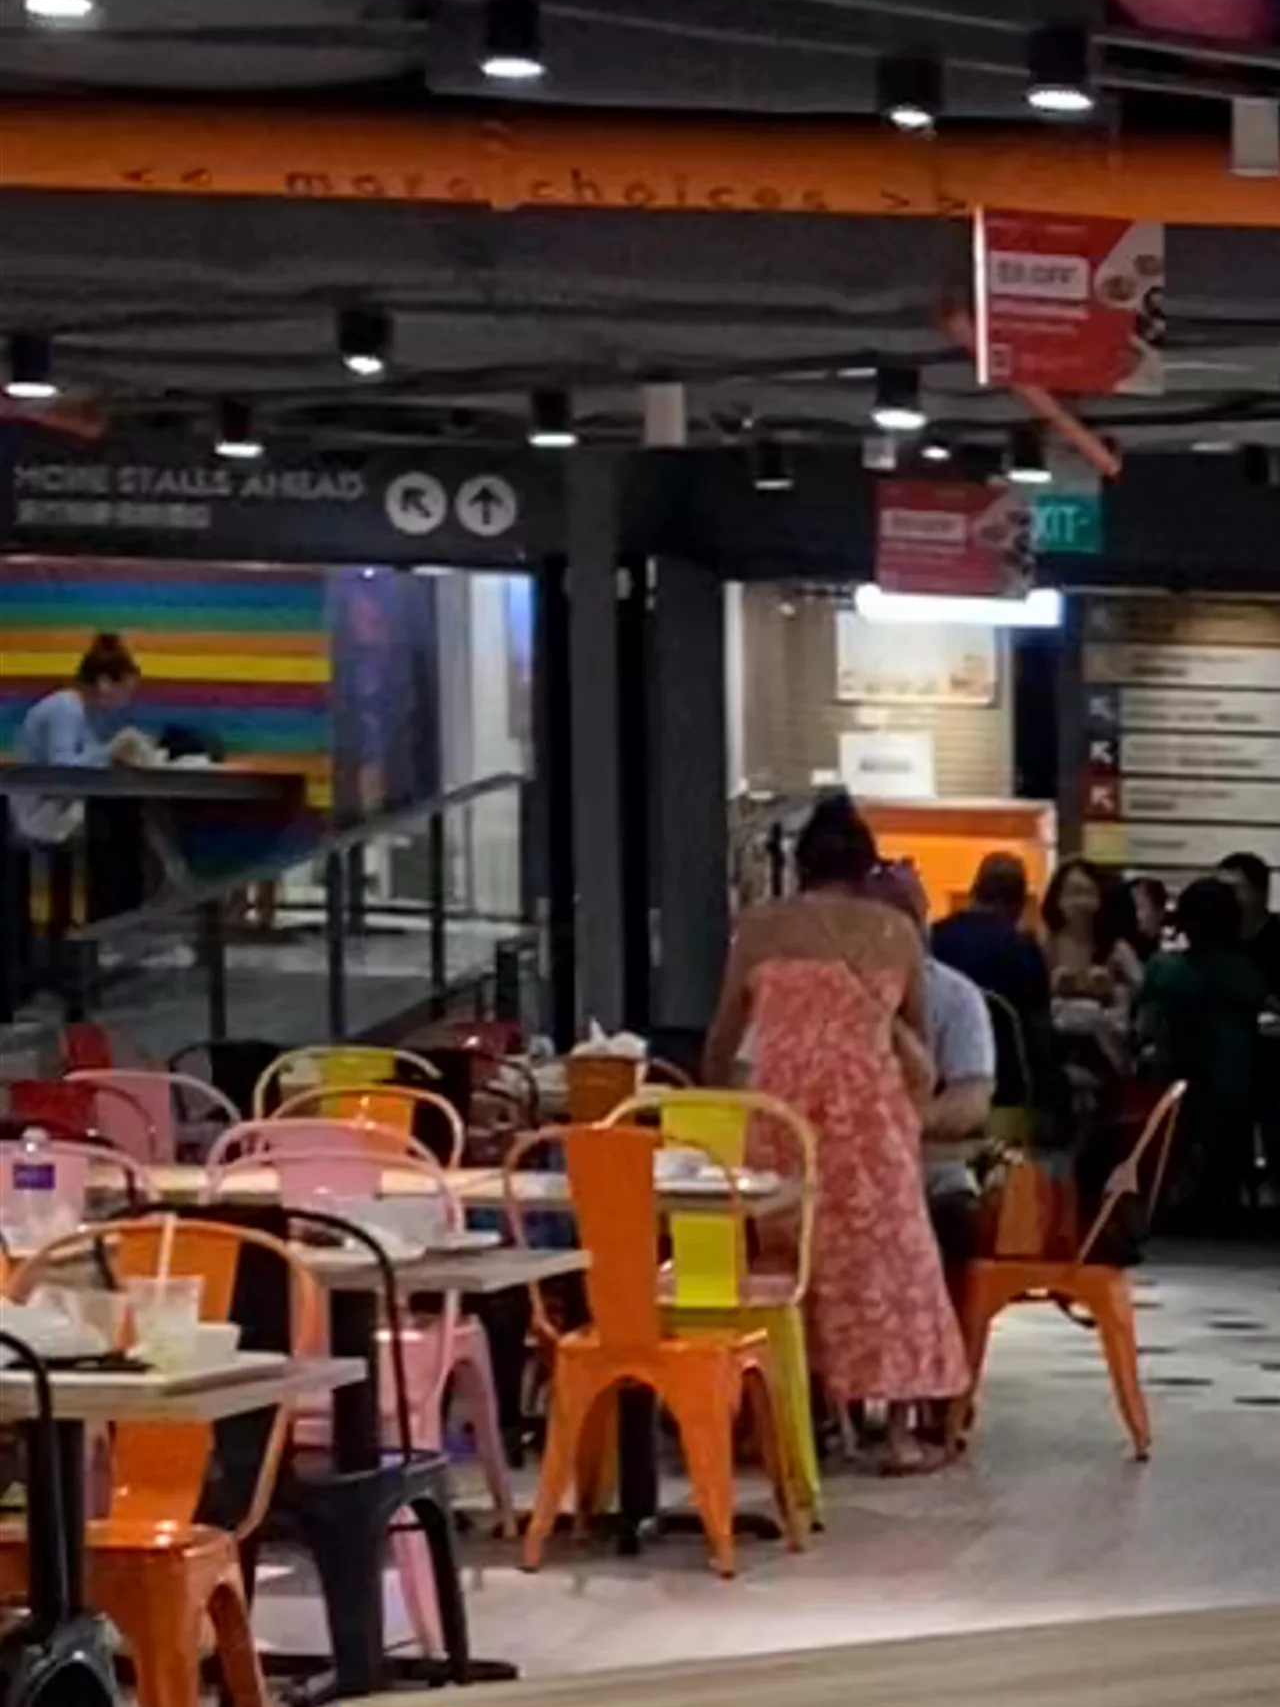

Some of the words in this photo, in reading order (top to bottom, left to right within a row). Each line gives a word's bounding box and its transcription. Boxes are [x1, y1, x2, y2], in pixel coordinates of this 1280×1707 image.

[285, 169, 475, 199] more
[529, 168, 828, 211] choices
[14, 465, 109, 493] MORE
[117, 466, 233, 496] STALLS
[239, 470, 366, 501] AHEAD
